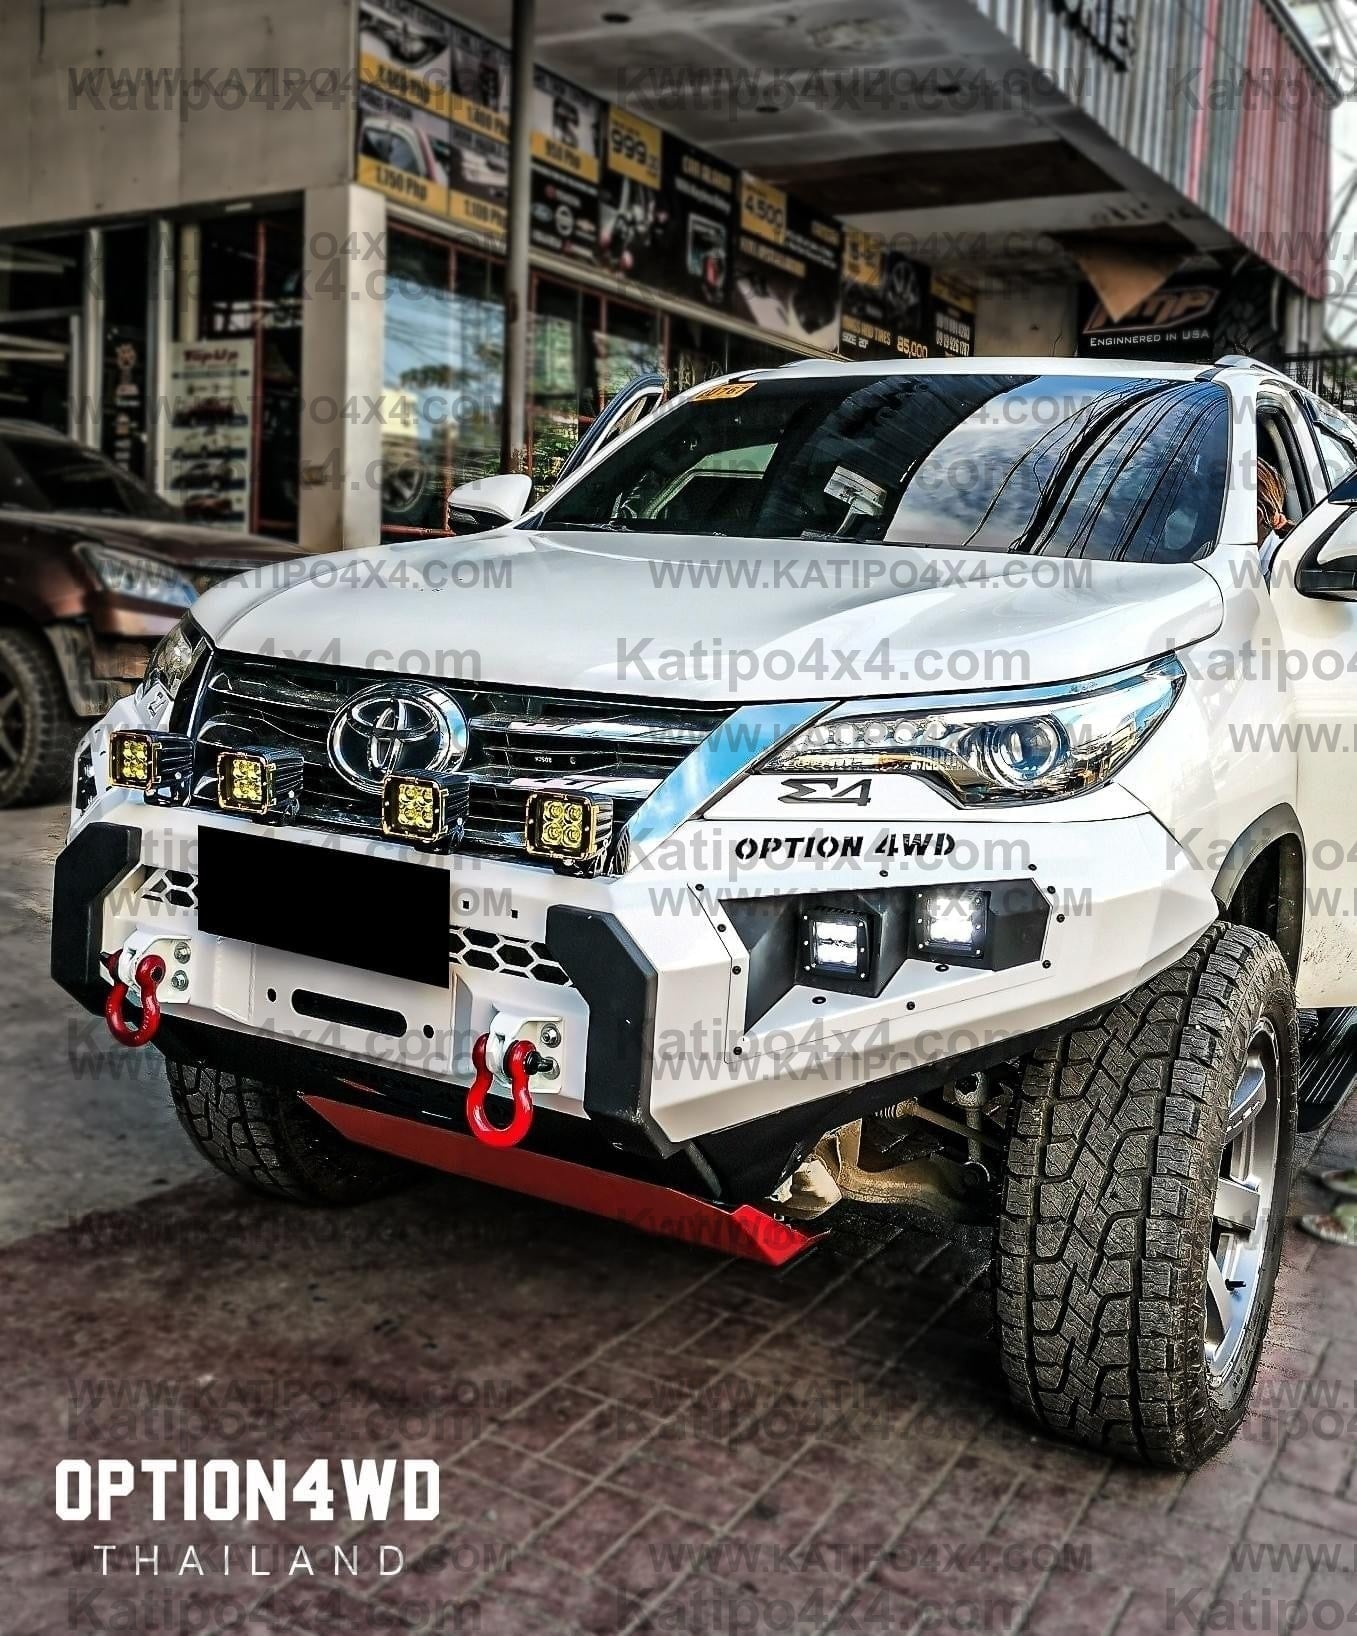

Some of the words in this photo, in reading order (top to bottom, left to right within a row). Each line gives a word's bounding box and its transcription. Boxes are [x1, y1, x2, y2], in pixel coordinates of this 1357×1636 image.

[611, 128, 647, 166] 999
[1089, 333, 1161, 347] ENGINNERED
[1166, 332, 1177, 342] IN
[1182, 329, 1210, 341] USA
[735, 835, 864, 860] OPTION
[875, 832, 956, 857] 4WD
